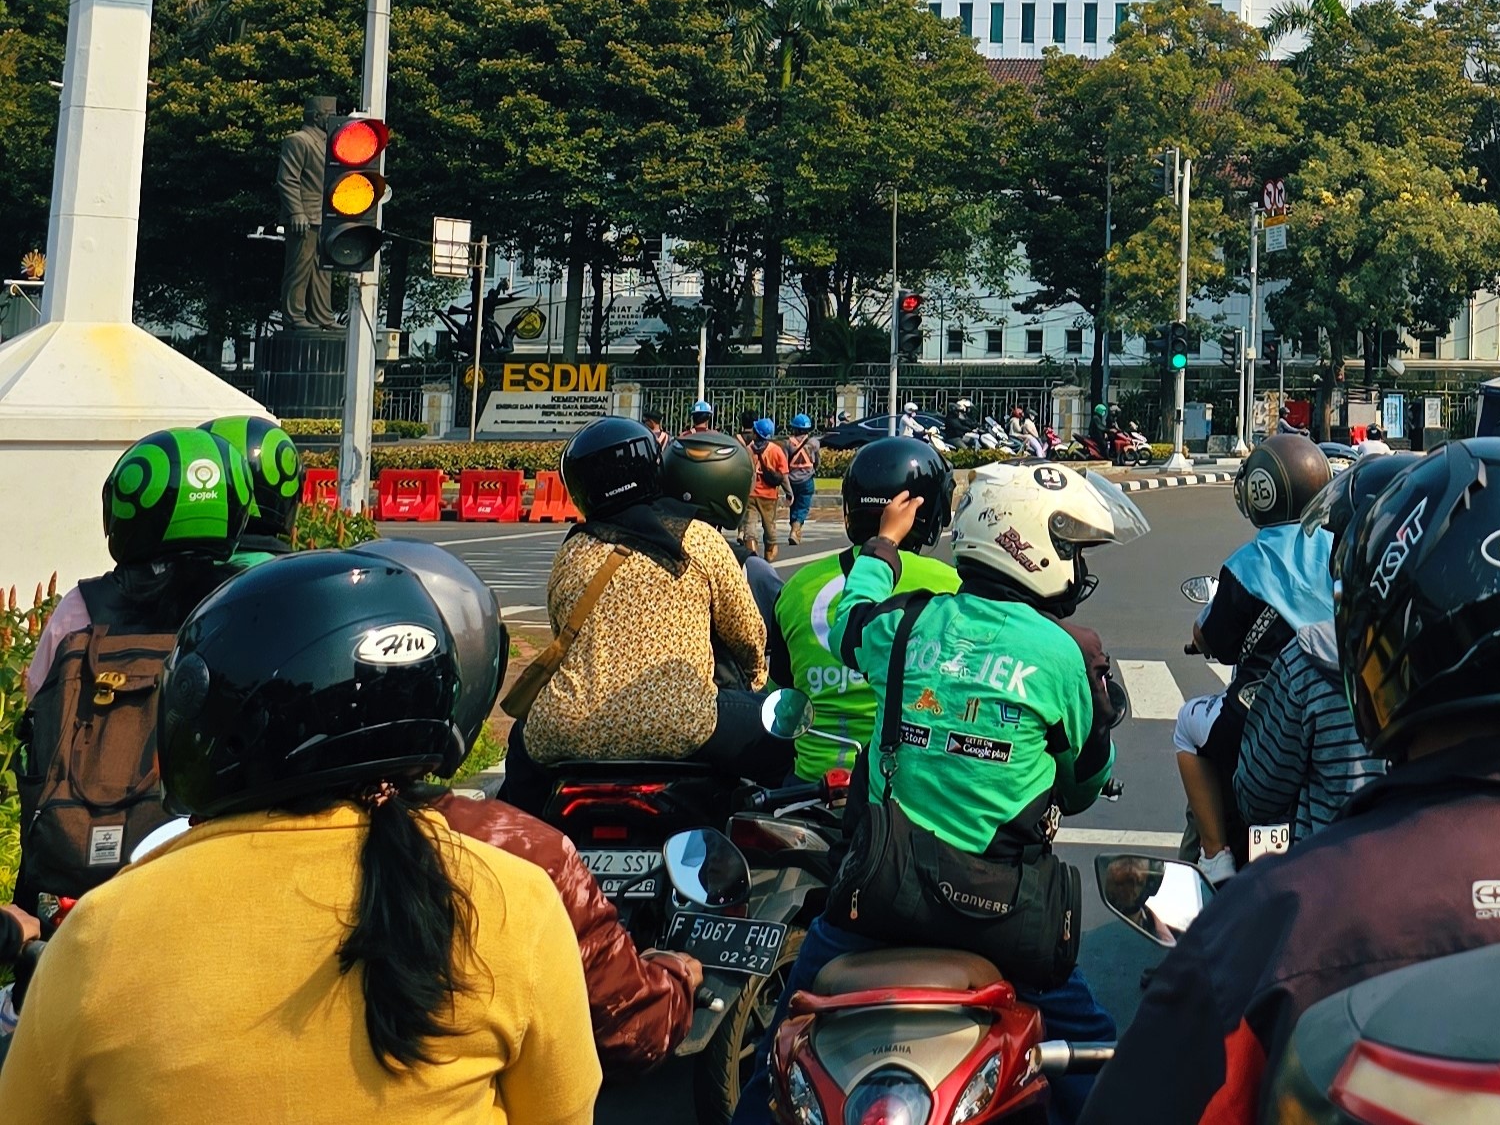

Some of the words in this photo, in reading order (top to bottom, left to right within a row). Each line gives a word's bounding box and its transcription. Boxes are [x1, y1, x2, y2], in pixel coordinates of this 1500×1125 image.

[503, 363, 608, 392] ESDM
[189, 490, 218, 503] gojek
[605, 481, 638, 498] HONDA
[1251, 479, 1271, 501] 36
[860, 497, 893, 505] HONDA
[376, 633, 426, 656] Hiu
[807, 665, 865, 694] goje
[973, 652, 1038, 699] JEK
[904, 733, 928, 745] Store
[962, 744, 992, 758] Google
[991, 749, 1008, 761] play
[1254, 829, 1262, 845] B
[1270, 828, 1288, 843] 60
[623, 855, 656, 873] SSV
[954, 892, 1013, 914] CONVERS
[672, 917, 686, 937] F
[690, 919, 737, 943] 5067
[744, 925, 781, 949] FHD
[872, 1045, 912, 1055] YAMAHA
